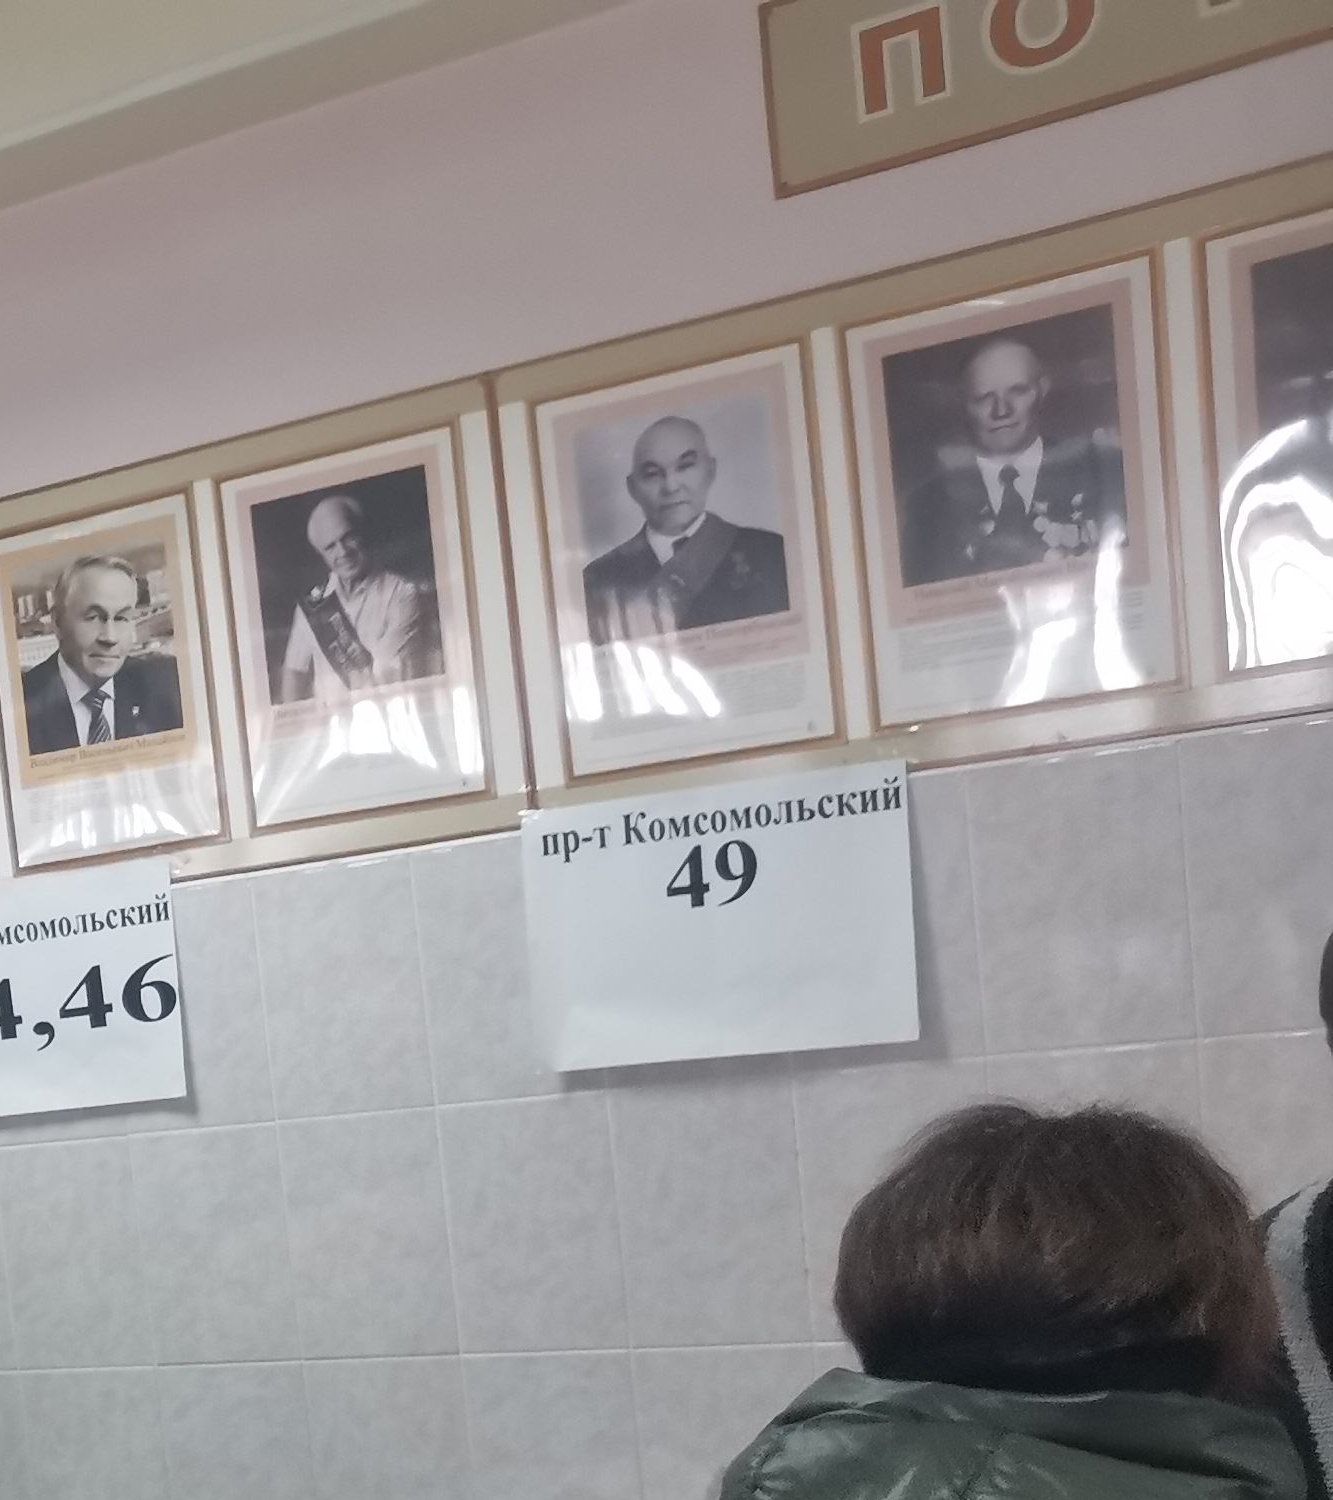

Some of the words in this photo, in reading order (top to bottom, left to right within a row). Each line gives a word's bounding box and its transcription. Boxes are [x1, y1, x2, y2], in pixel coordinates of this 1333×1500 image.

[541, 825, 612, 863] пр-т
[621, 775, 903, 847] Комсомольский
[666, 838, 759, 909] 49
